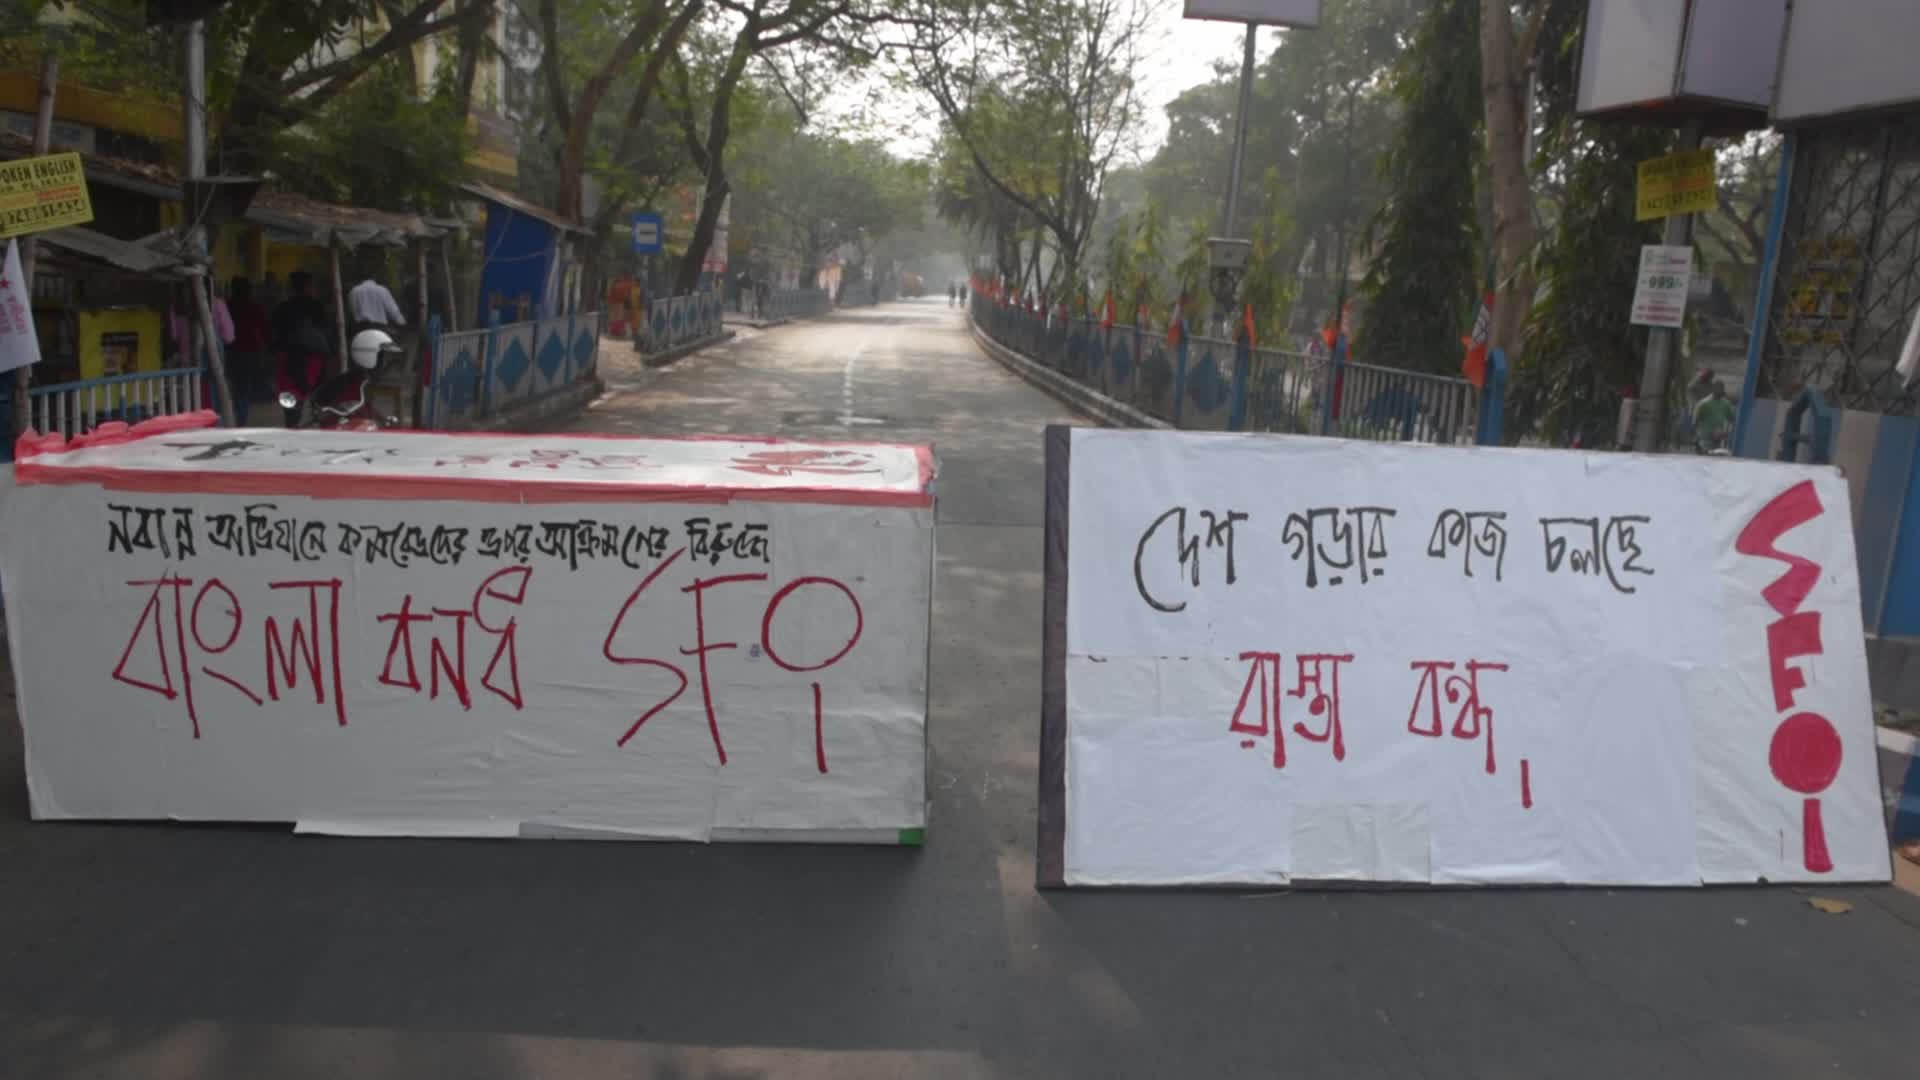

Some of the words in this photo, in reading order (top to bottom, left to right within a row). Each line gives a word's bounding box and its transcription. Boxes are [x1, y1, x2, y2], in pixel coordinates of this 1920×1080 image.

[33, 159, 77, 179] ENGLISH
[107, 503, 197, 561] নবান্ন
[204, 503, 327, 562] অভিযানে
[1133, 506, 1249, 613] দেশ
[1281, 506, 1397, 589] গড়ার
[1427, 508, 1507, 582] কাজ
[1539, 515, 1656, 594] চলছে
[113, 570, 347, 740] বাংলা
[1229, 651, 1355, 770] রাস্তা
